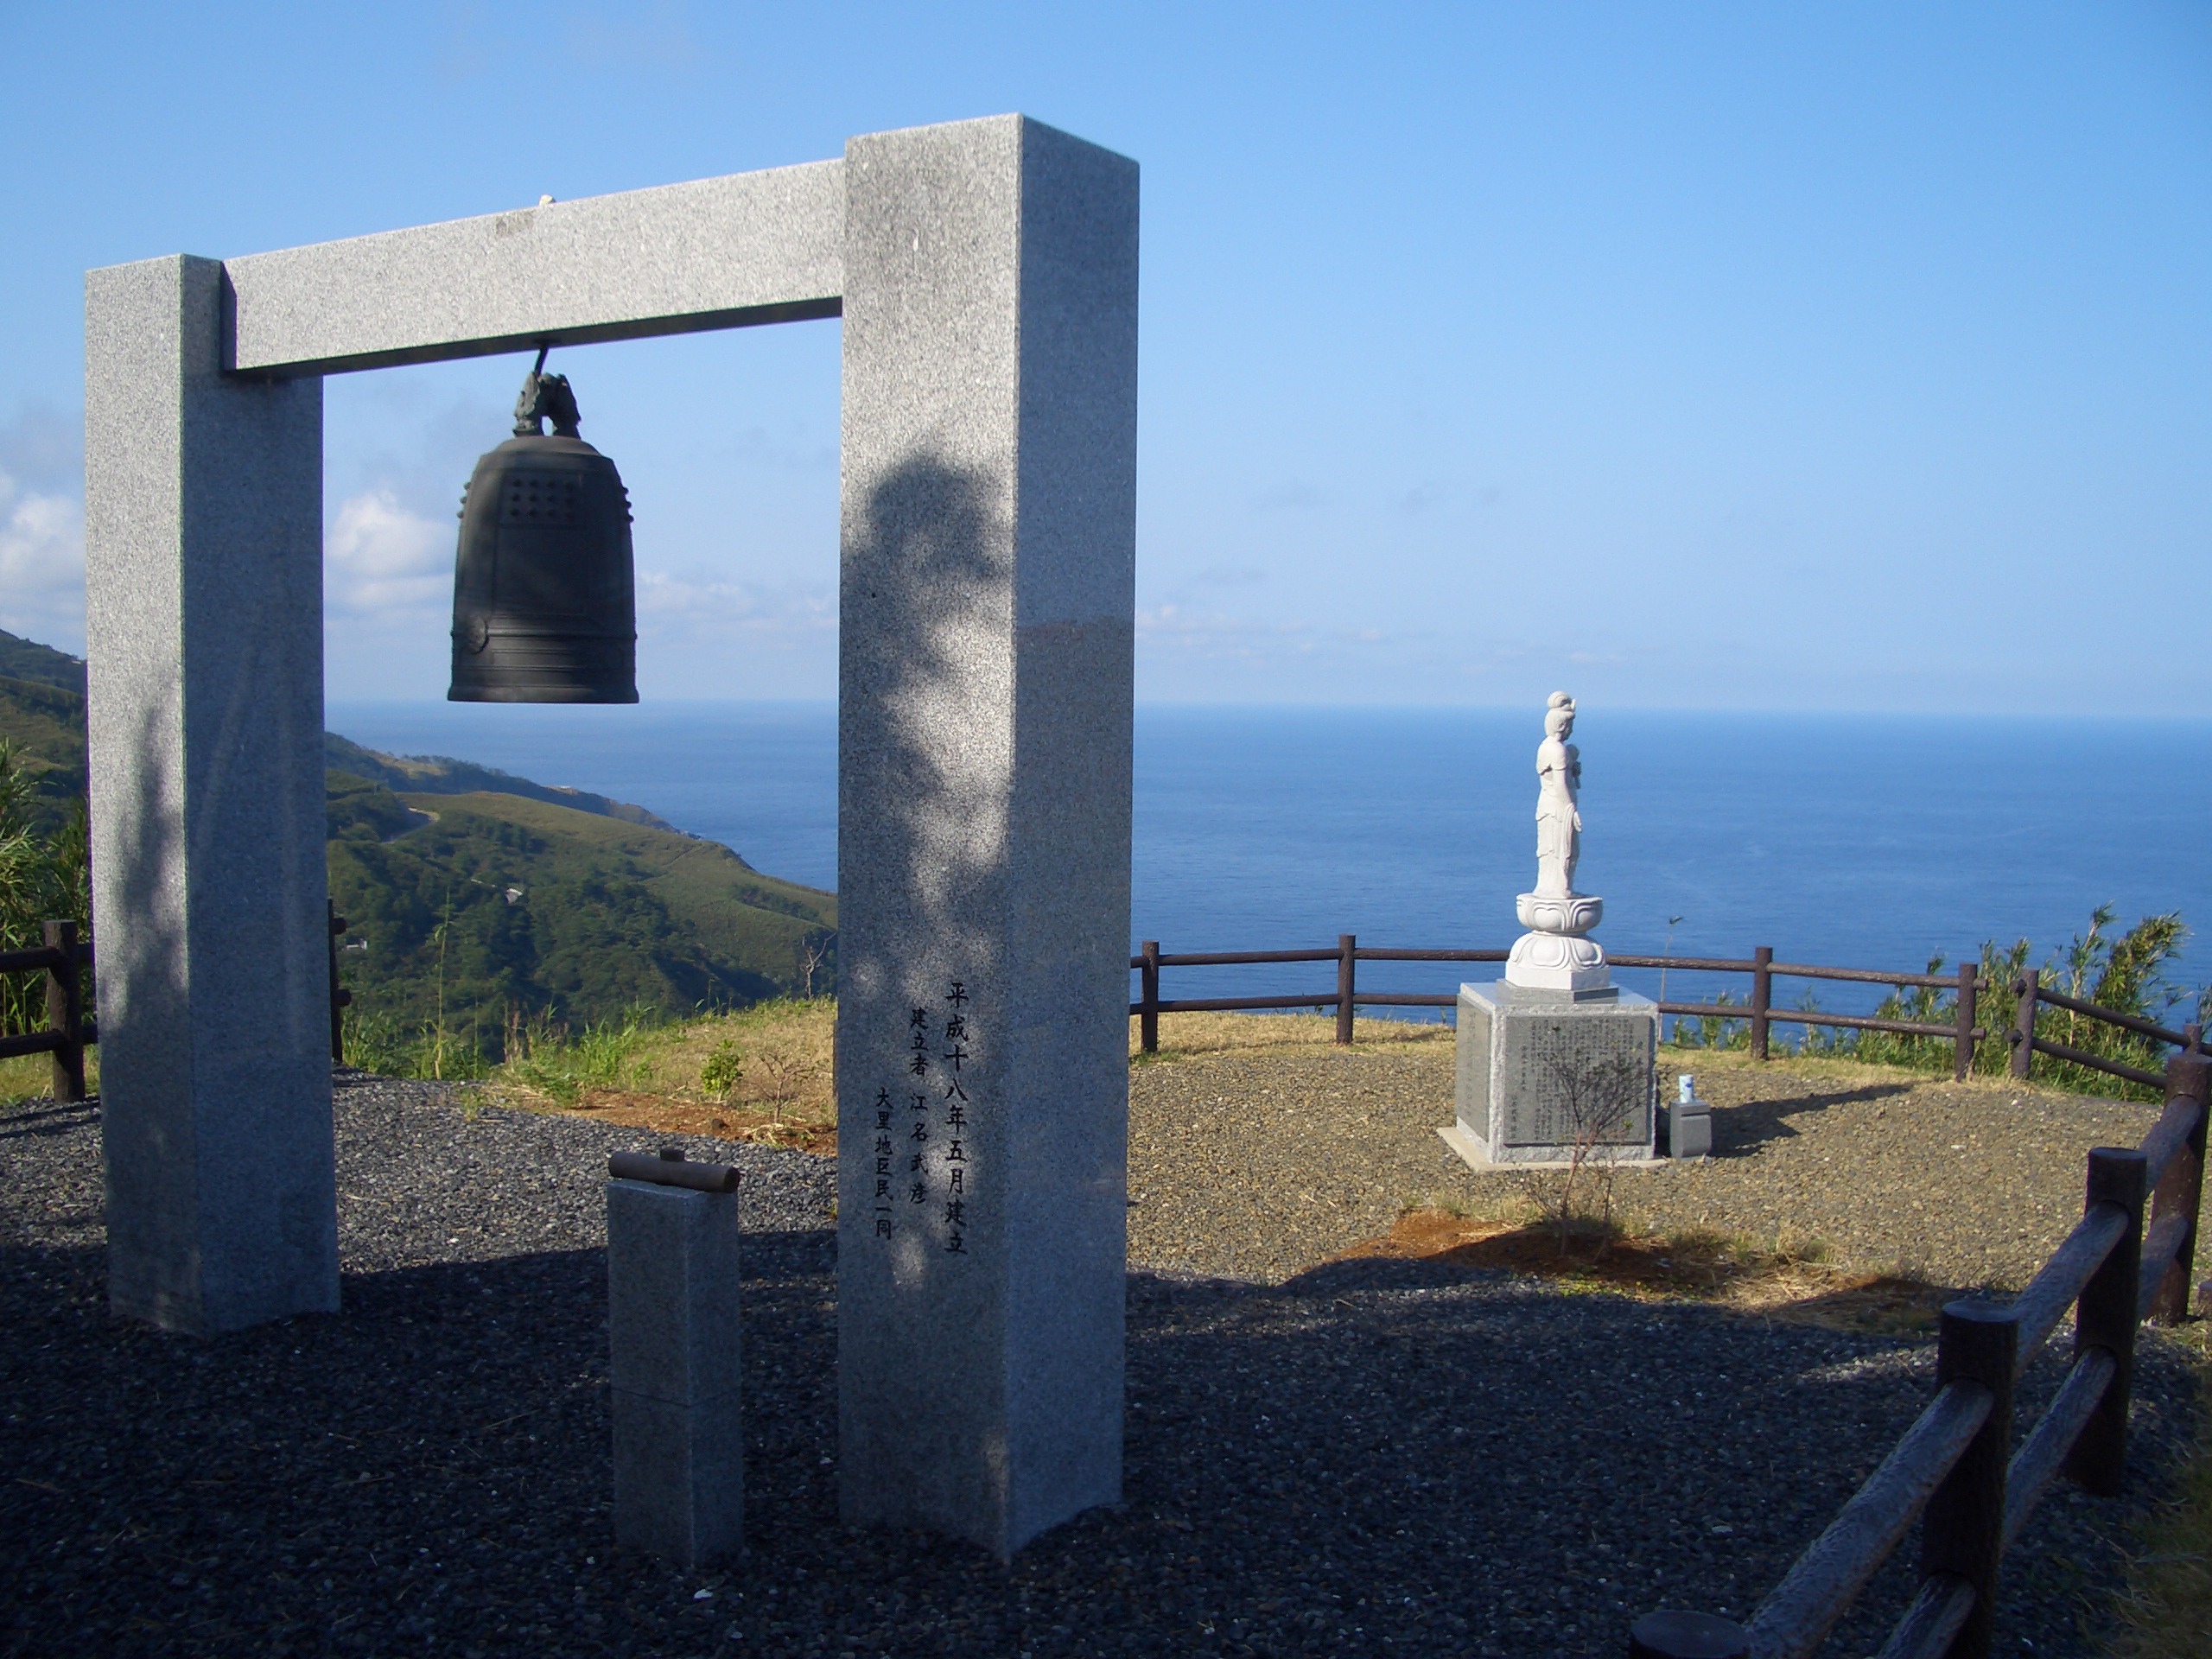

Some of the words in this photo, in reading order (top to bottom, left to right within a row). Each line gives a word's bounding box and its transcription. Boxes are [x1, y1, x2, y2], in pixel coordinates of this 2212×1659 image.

[910, 1007, 929, 1077] 建立者
[874, 1087, 893, 1241] 大里地区民一同
[910, 1092, 929, 1205] 江名武彦
[944, 982, 969, 1255] 平成十八年五月建立
